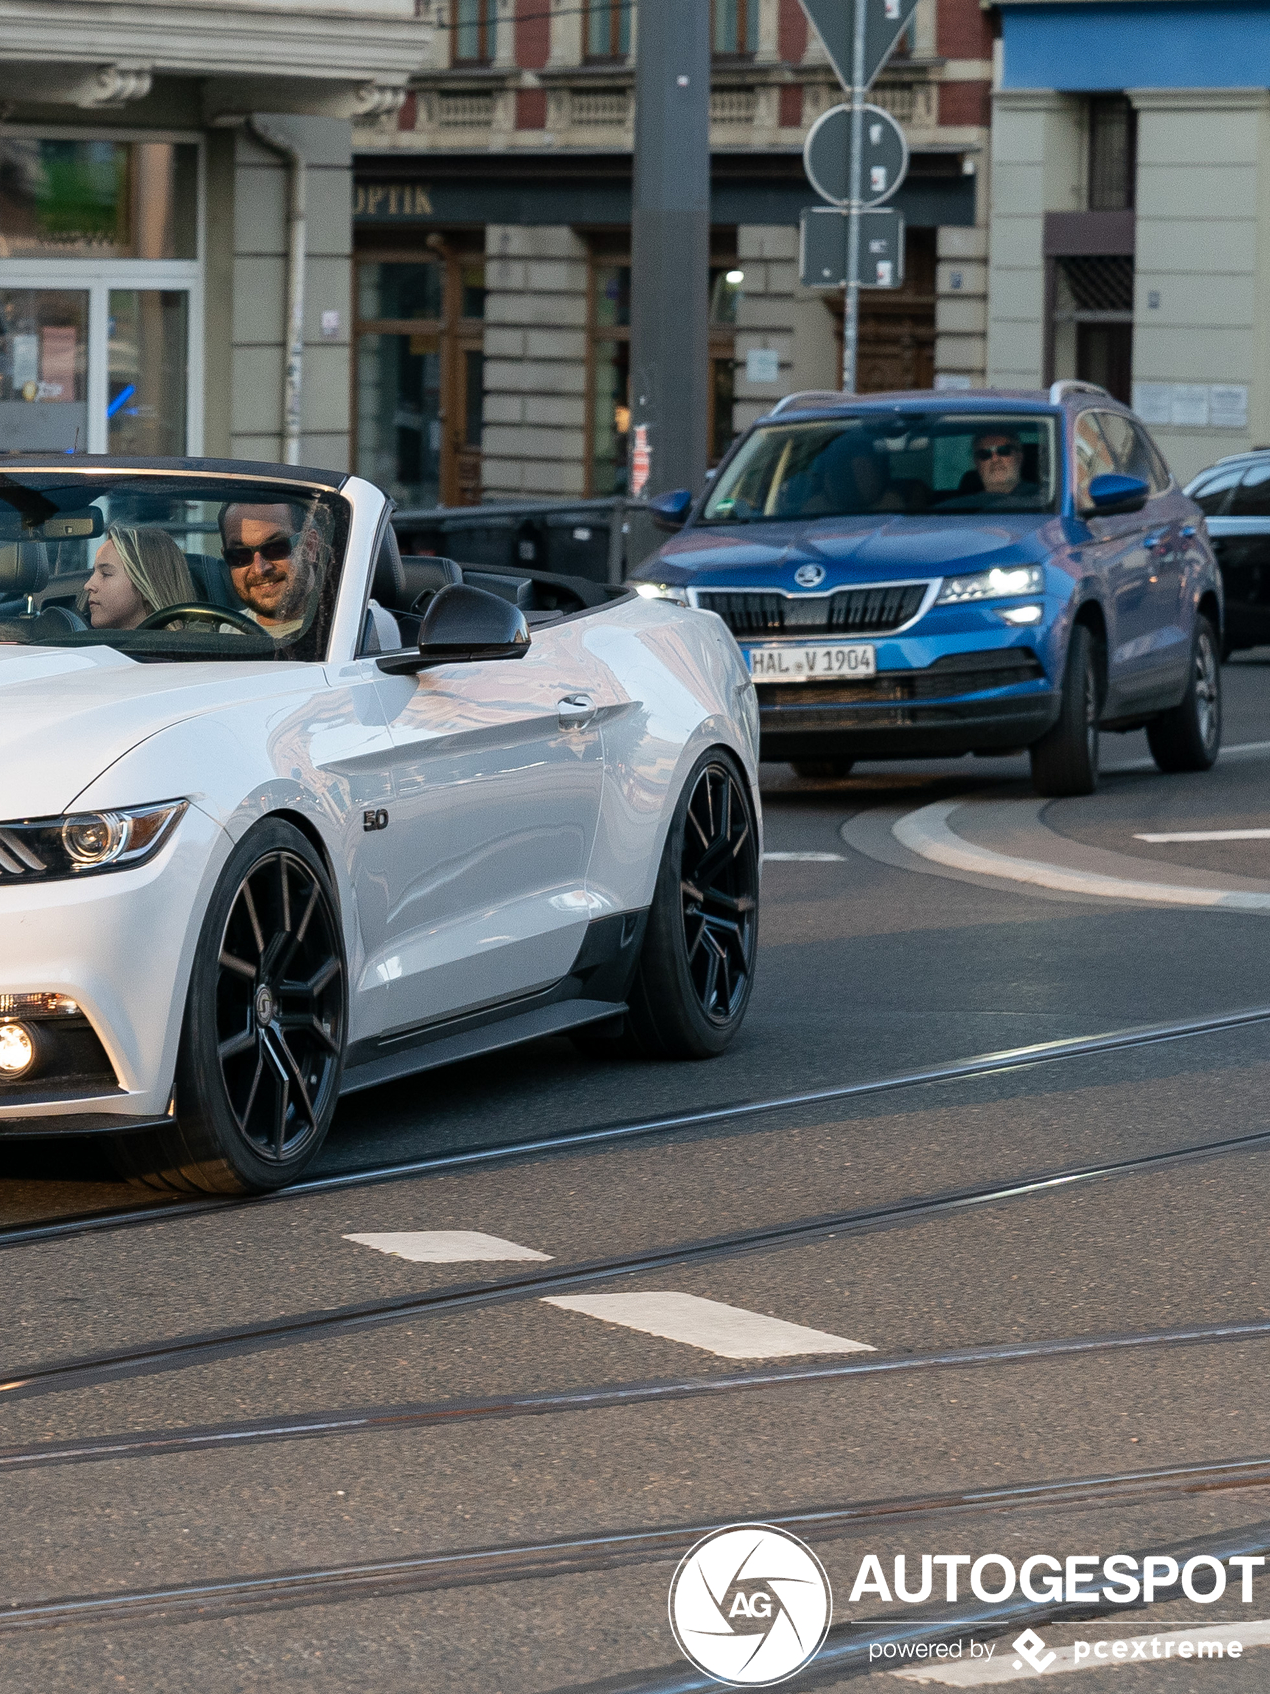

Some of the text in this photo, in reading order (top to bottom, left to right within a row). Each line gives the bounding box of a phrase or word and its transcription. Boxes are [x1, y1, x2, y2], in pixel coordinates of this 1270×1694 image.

[752, 649, 870, 673] HAL V 1904
